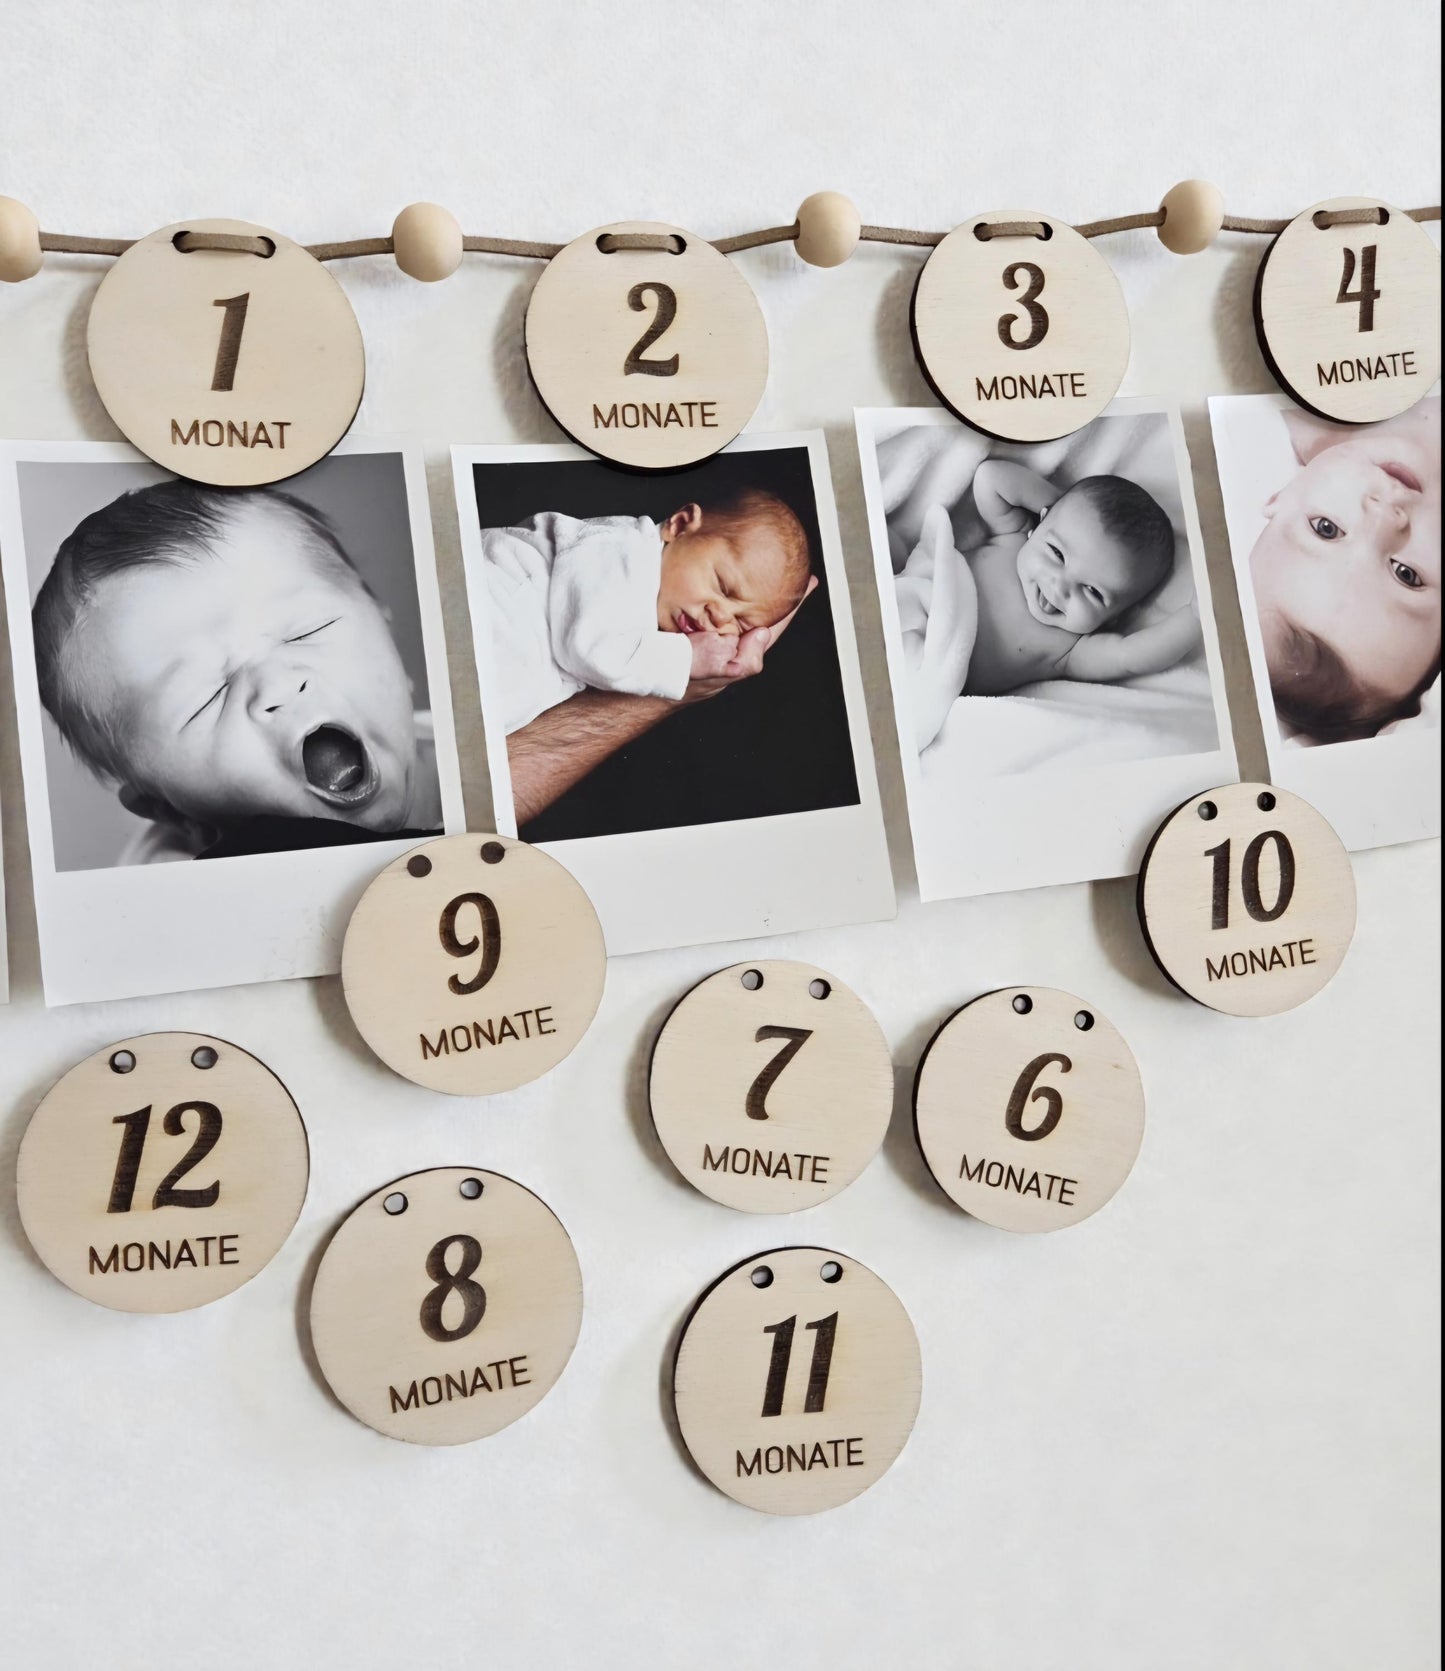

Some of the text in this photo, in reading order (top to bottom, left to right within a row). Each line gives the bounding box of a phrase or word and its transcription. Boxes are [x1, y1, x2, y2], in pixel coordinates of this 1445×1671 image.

[624, 282, 679, 377] 2
[998, 262, 1049, 350] 3
[1336, 245, 1381, 332] 4
[211, 292, 249, 392] 1
[1317, 351, 1417, 386] MONATE
[593, 402, 718, 428] MONATE
[976, 373, 1087, 400] MONATE
[171, 419, 291, 449] MONAT
[1204, 830, 1295, 930] 10
[439, 893, 501, 995] 9
[1206, 939, 1316, 981] MONATE
[746, 1025, 814, 1120] 7
[1006, 1053, 1072, 1141] 6
[107, 1101, 222, 1213] 12
[703, 1144, 830, 1183] MONATE
[959, 1154, 1079, 1206] MONATE
[89, 1235, 239, 1274] MONATE
[420, 1235, 486, 1342] 8
[389, 1355, 531, 1413] MONATE
[761, 1311, 838, 1417] 11
[737, 1438, 864, 1477] MONATE
